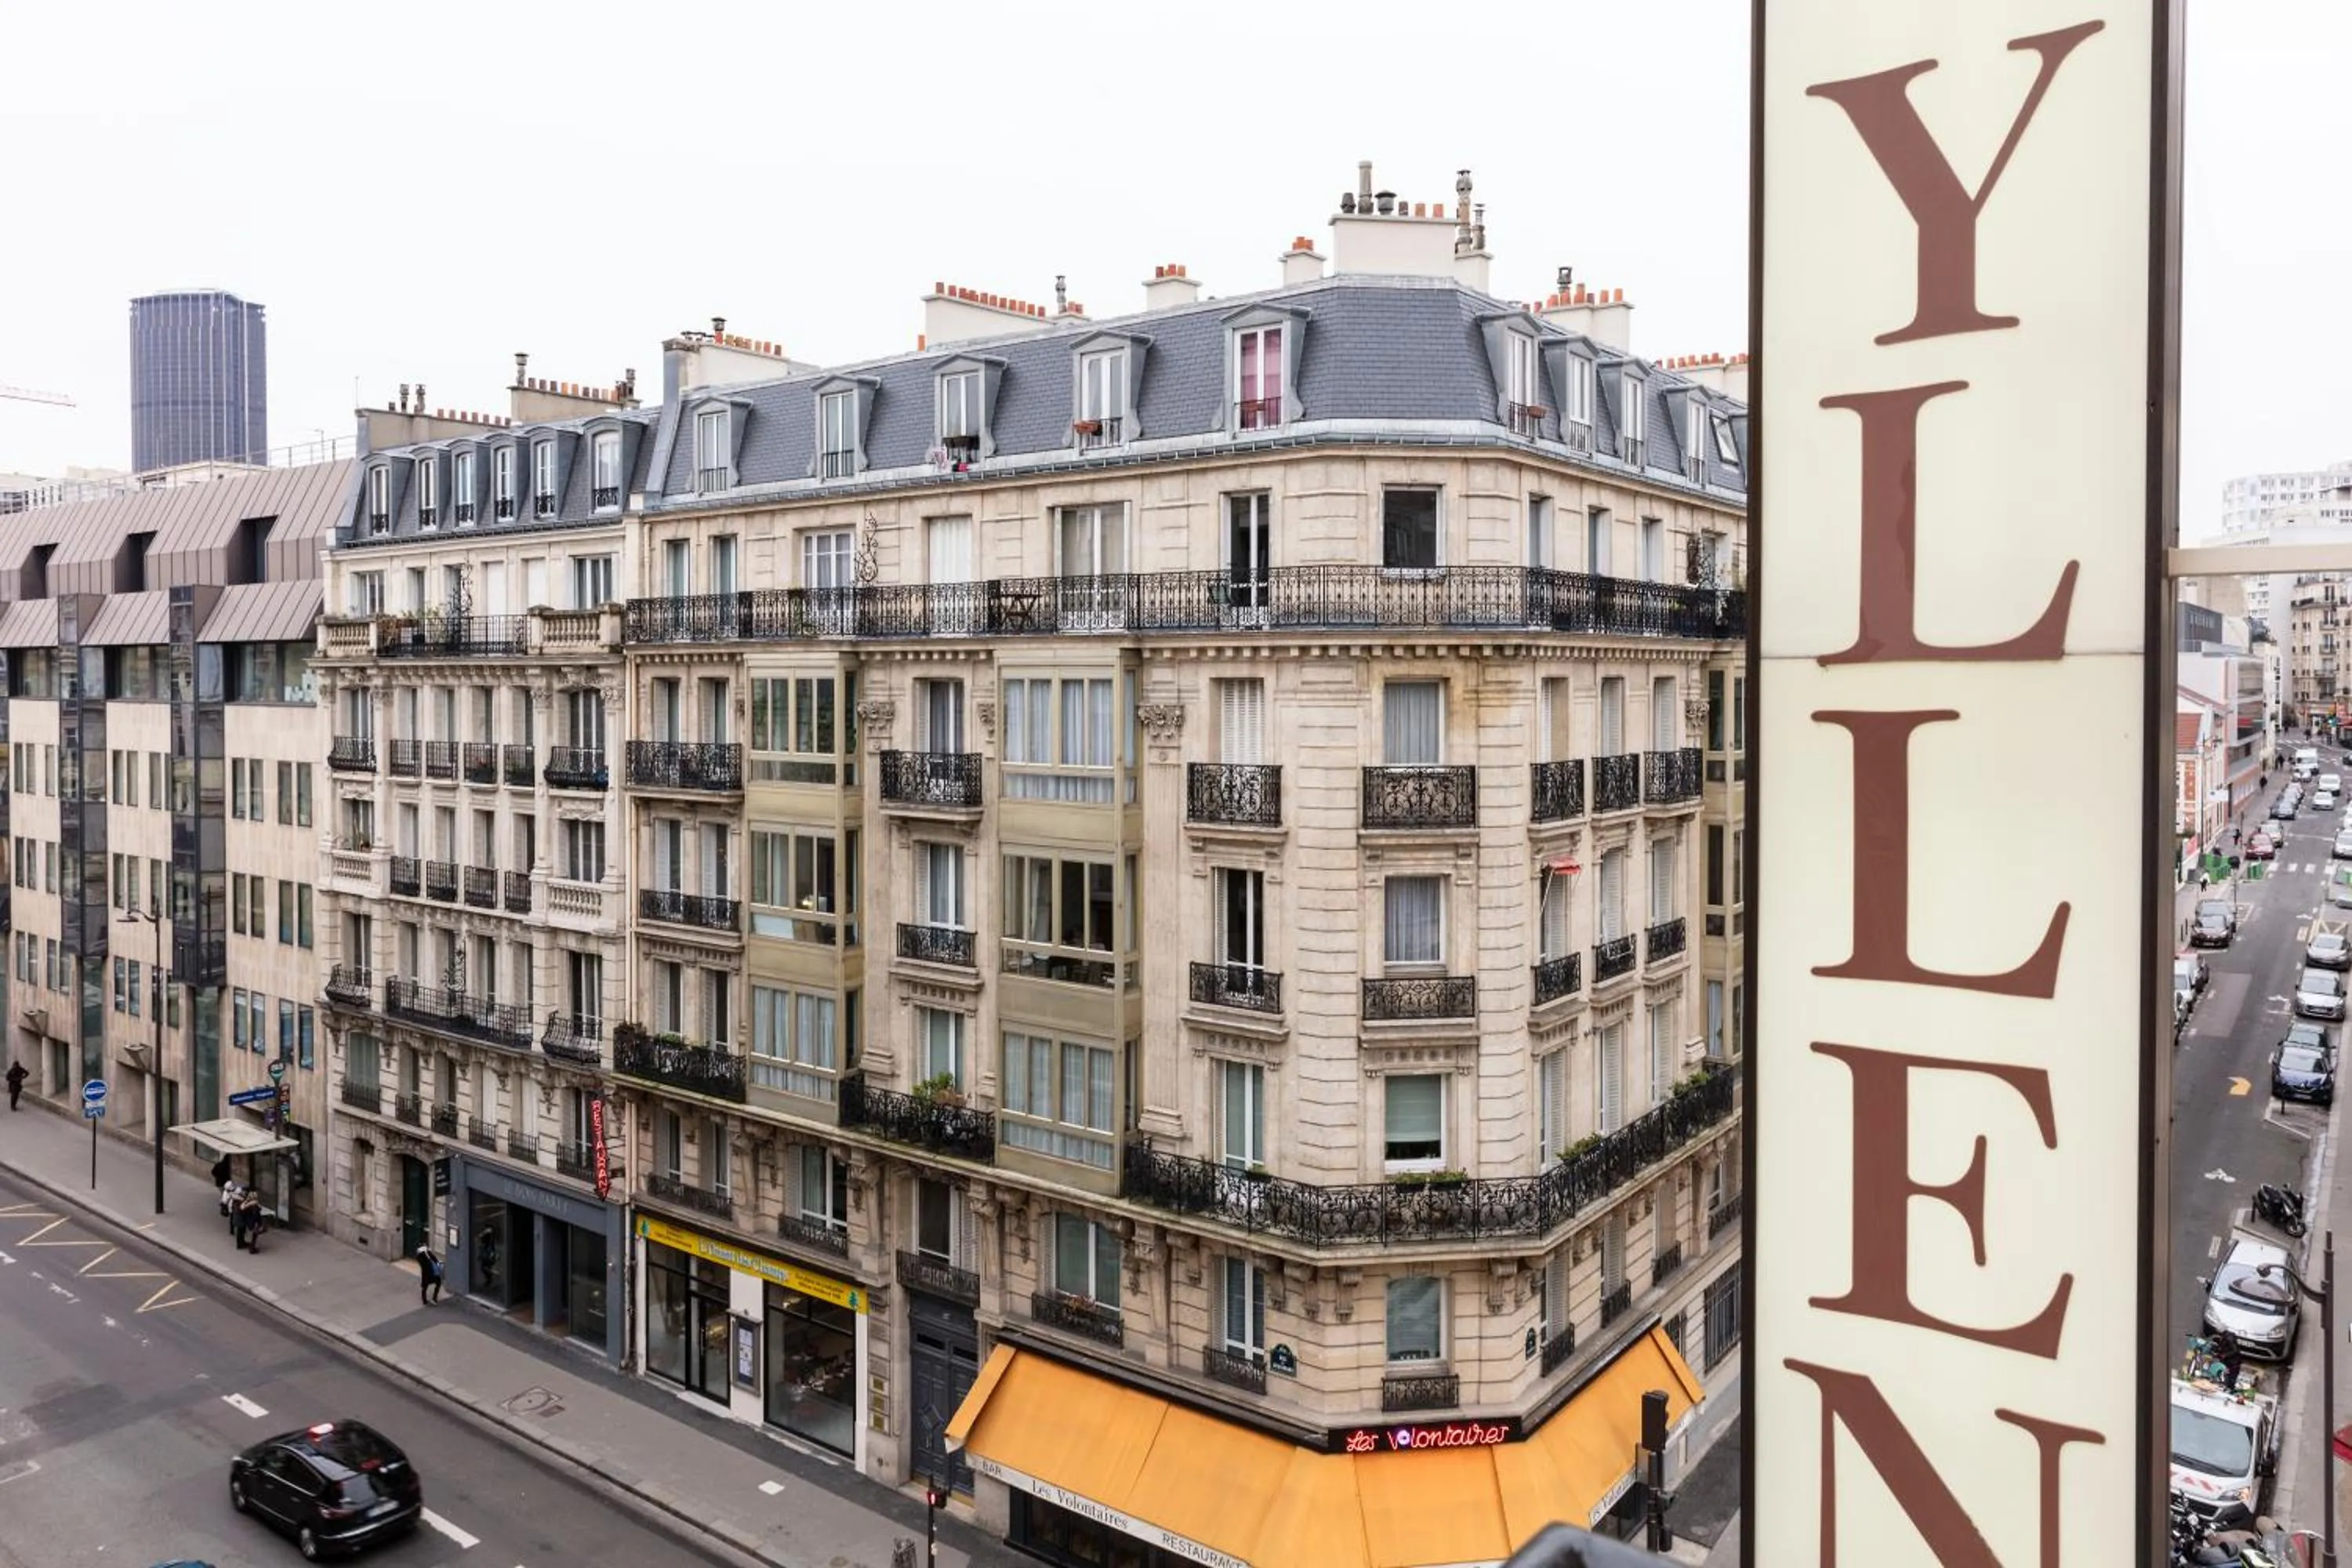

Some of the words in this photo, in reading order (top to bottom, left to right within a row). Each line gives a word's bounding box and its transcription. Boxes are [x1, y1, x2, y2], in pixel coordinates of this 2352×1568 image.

[1783, 19, 2107, 1568] YLLEN
[1346, 1430, 1379, 1453] Les
[1387, 1423, 1509, 1450] Volontaires
[982, 1461, 1004, 1479] BAR
[1032, 1479, 1051, 1500] Les
[1057, 1489, 1129, 1529] Volontaires
